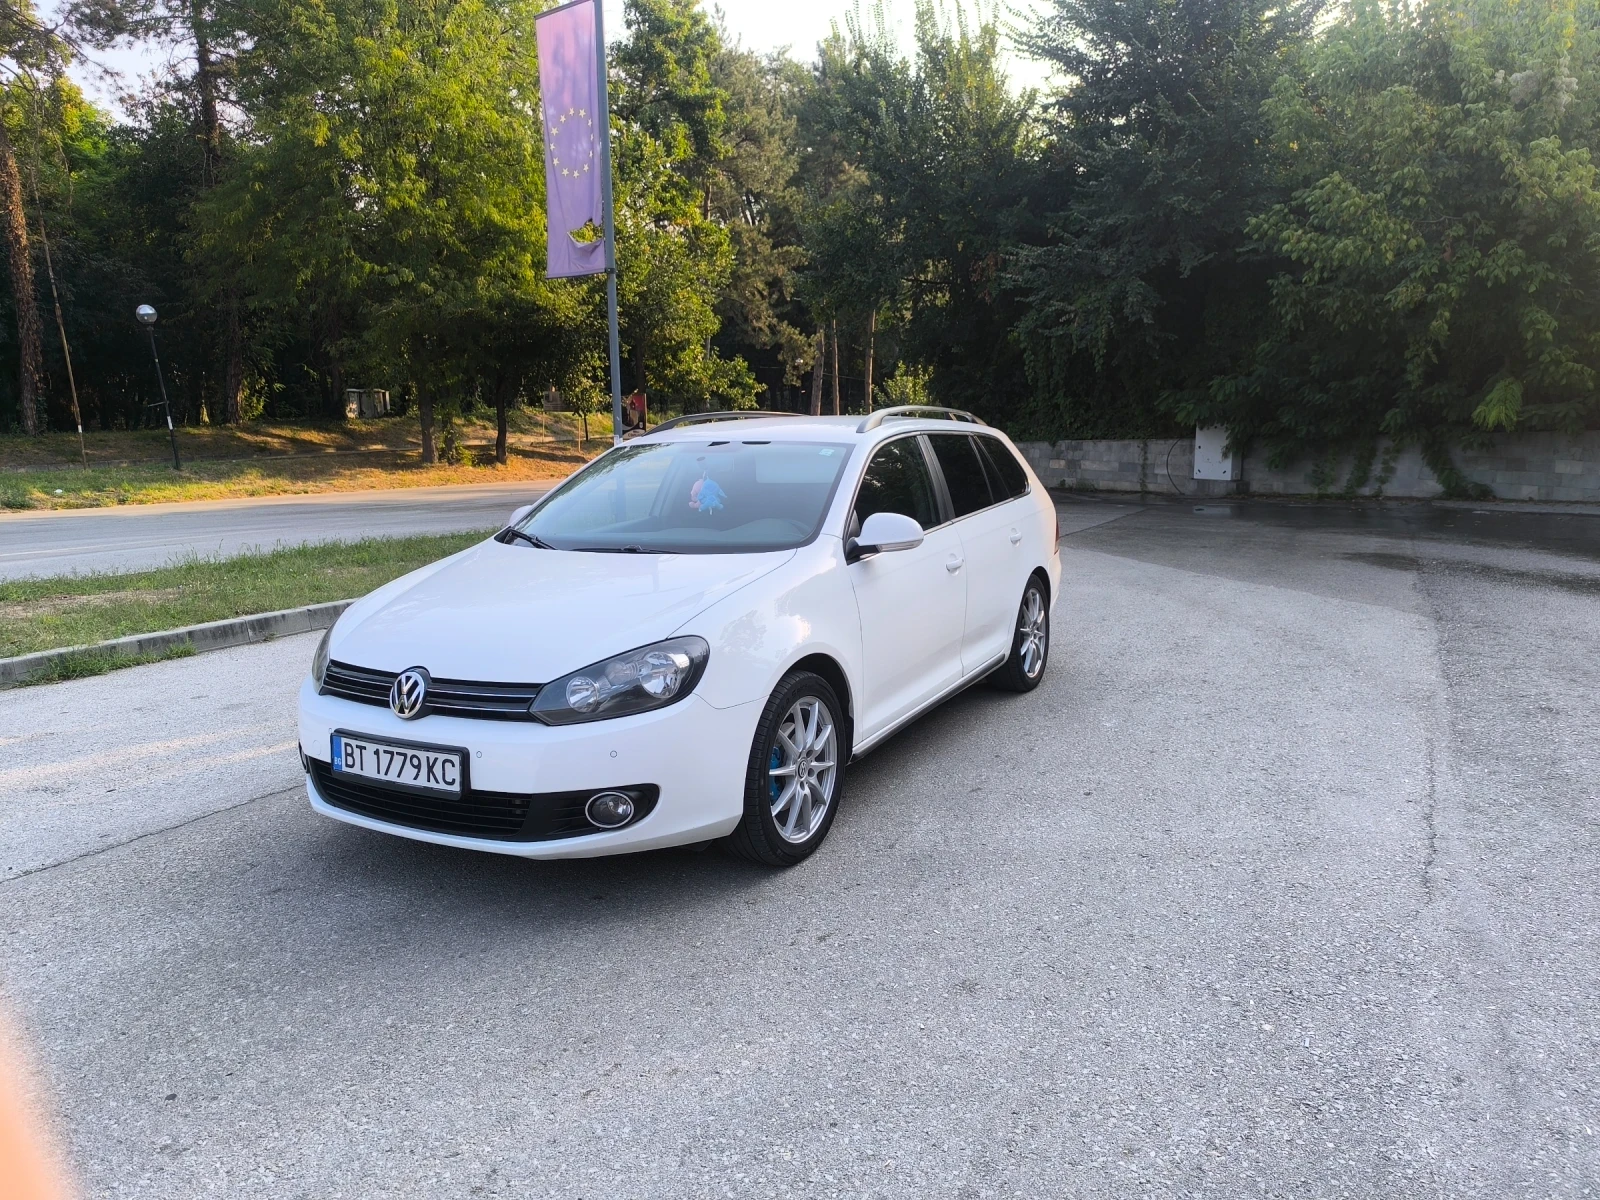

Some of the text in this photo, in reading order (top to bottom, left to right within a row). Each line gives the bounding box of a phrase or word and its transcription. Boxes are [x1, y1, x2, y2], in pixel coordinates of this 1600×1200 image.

[344, 742, 456, 786] BT 1779 KC
